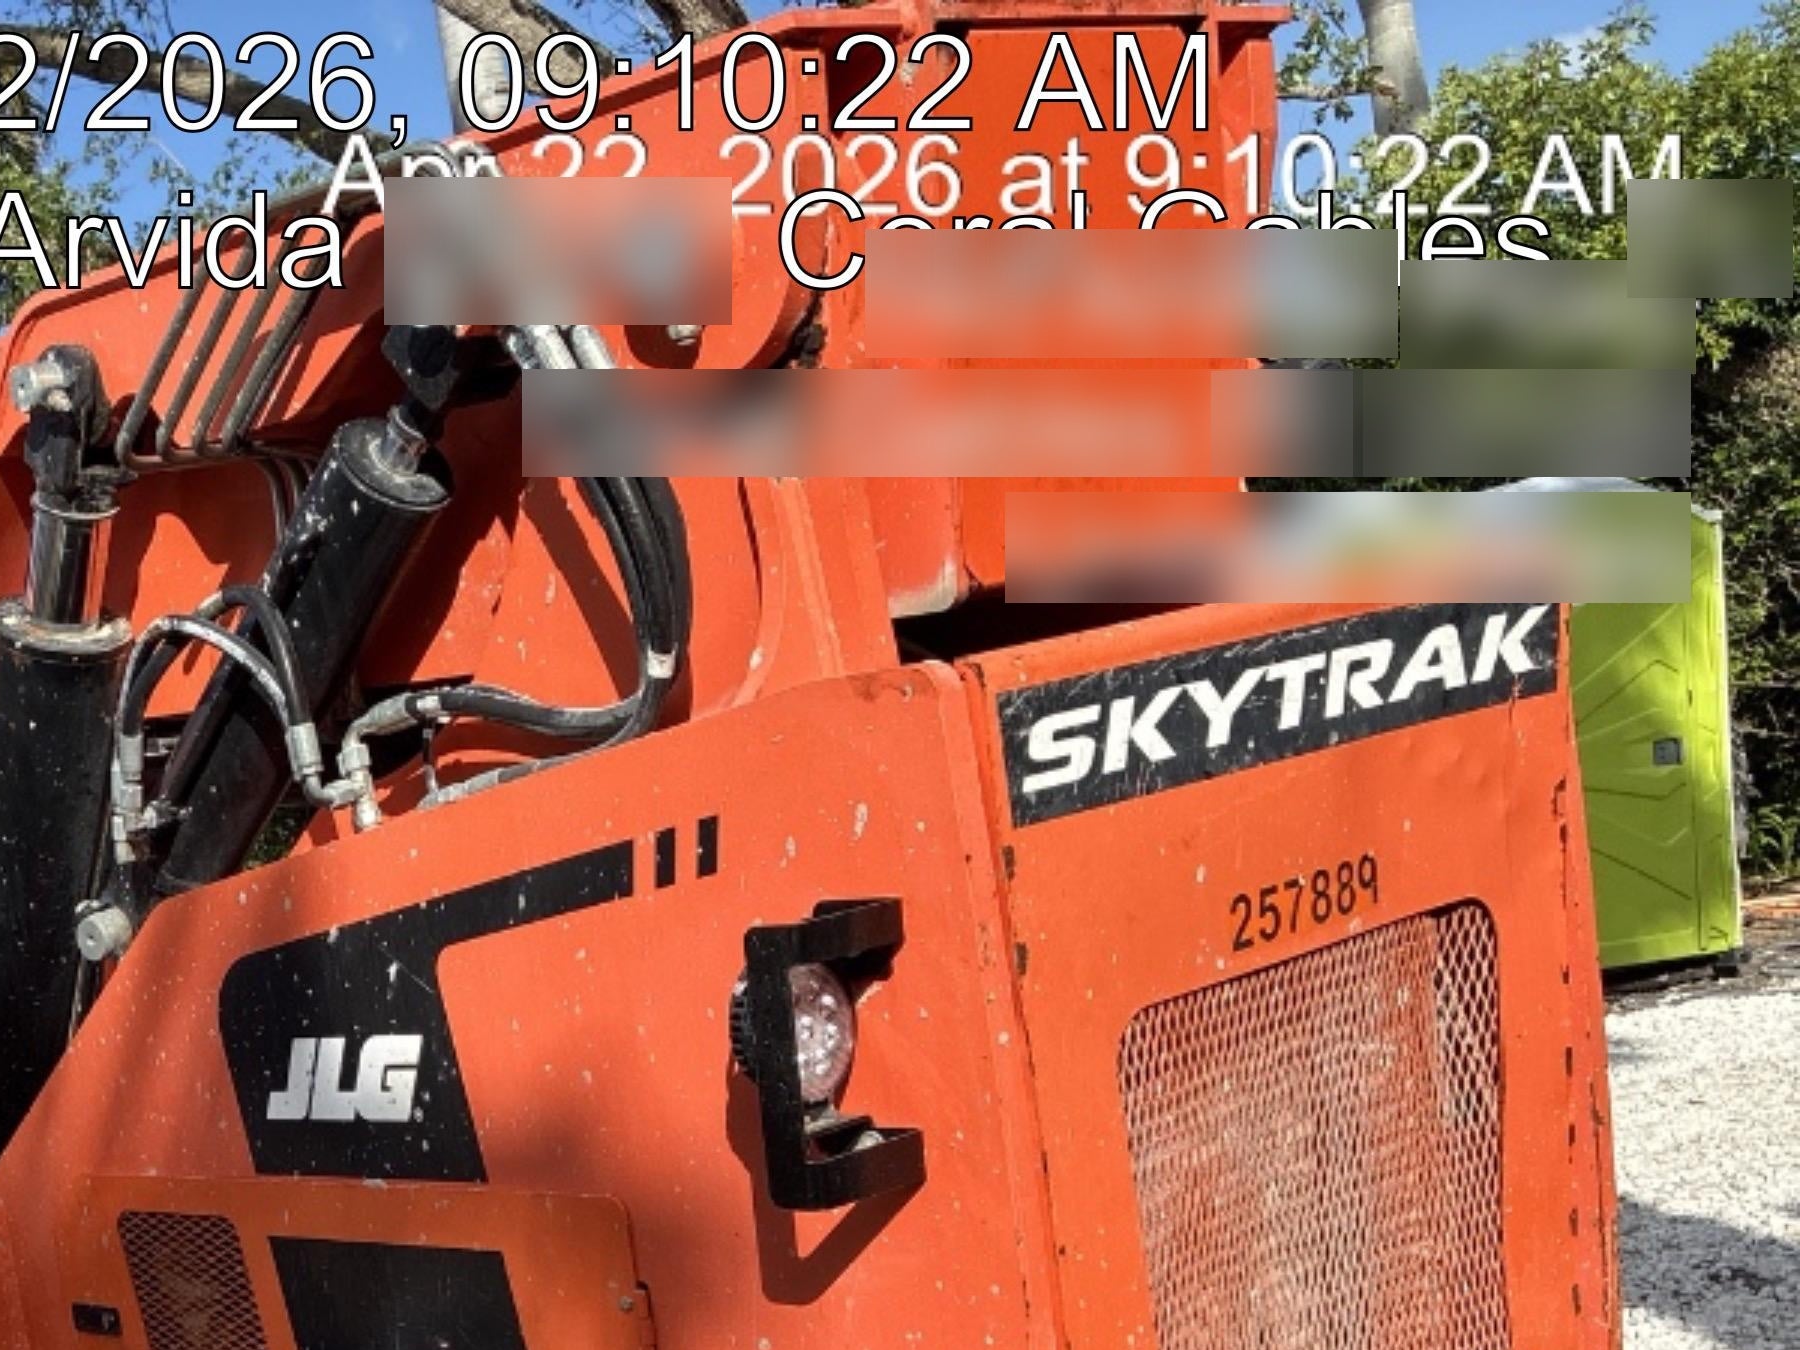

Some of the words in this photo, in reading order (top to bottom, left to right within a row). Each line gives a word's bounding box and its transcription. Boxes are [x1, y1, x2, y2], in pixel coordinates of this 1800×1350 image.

[1021, 603, 1551, 794] SKYTRAK
[1229, 853, 1379, 951] 257889
[266, 1034, 424, 1122] JLG
